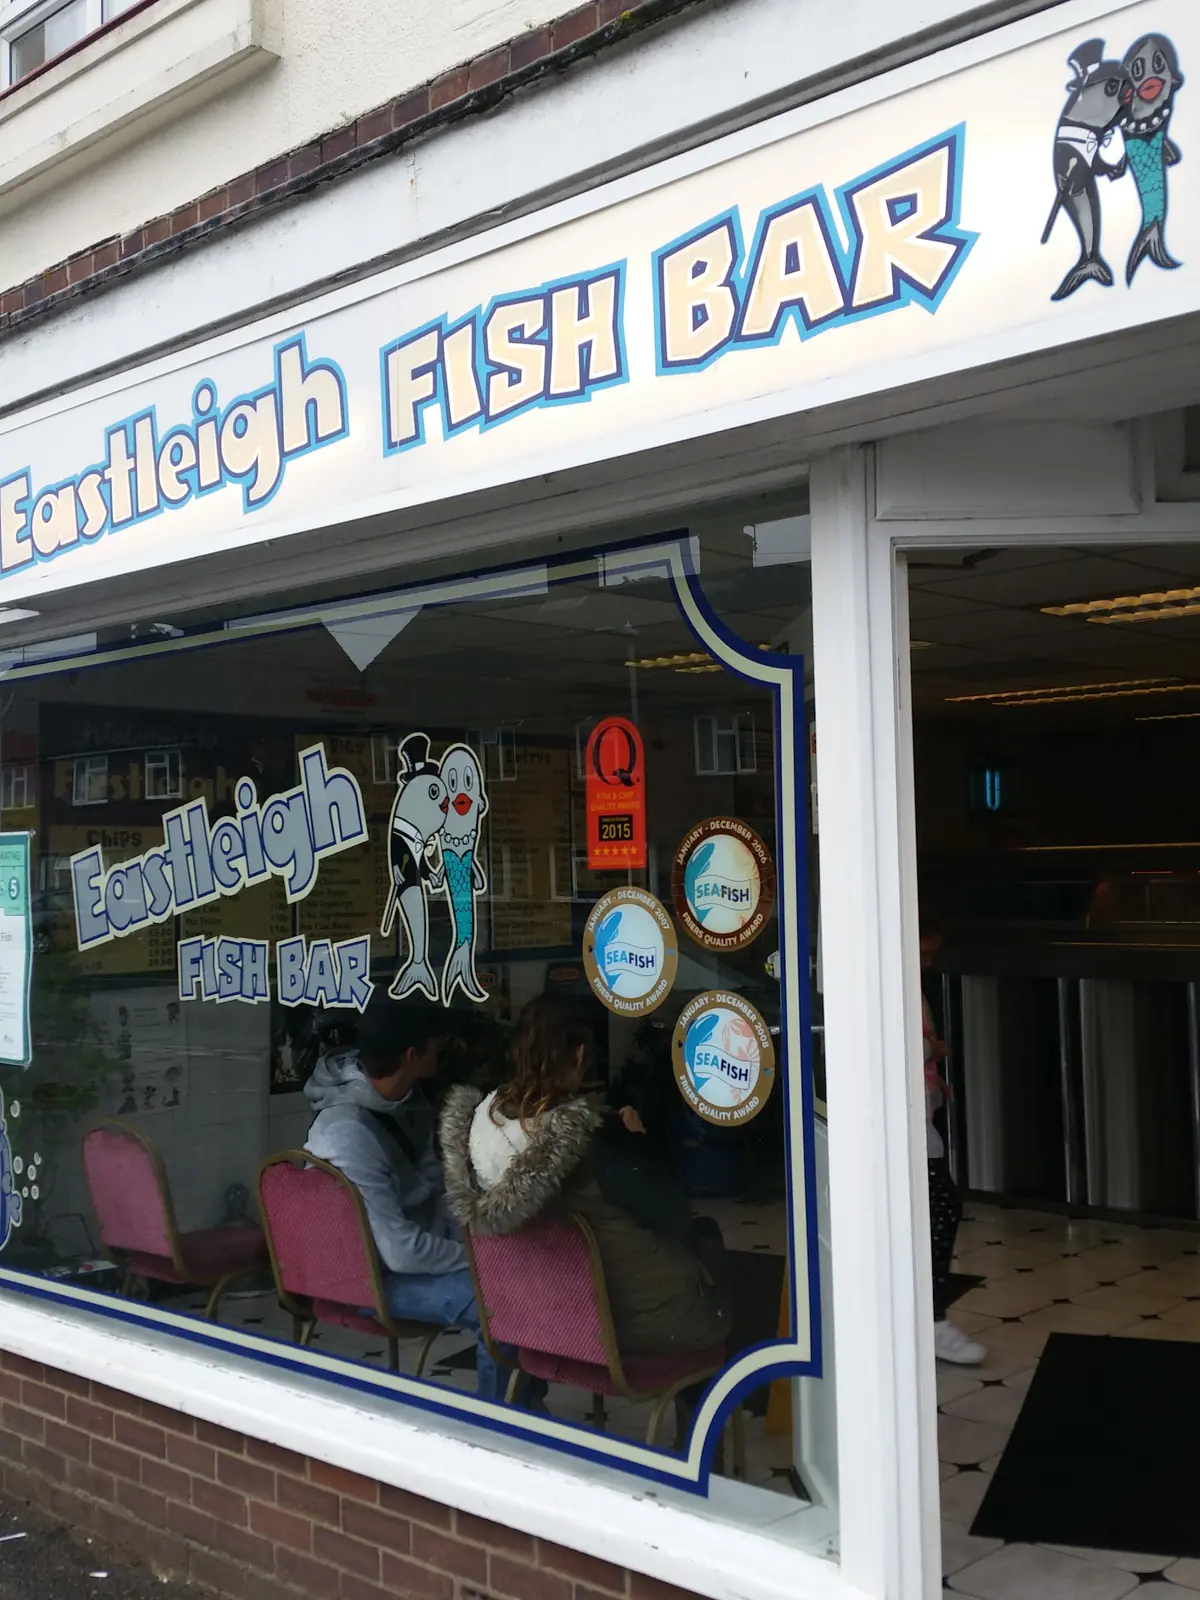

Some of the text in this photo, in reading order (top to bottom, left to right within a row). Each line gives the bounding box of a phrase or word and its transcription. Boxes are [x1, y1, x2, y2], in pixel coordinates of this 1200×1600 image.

[0, 122, 980, 578] Eastleigh FISH BAR
[70, 741, 369, 952] Eastleigh
[602, 823, 631, 839] 2015
[677, 827, 703, 865] JANUARY
[710, 820, 752, 841] DECEMBER
[751, 839, 768, 864] 2006
[10, 879, 19, 898] 5
[696, 883, 749, 903] SEAFISH
[588, 896, 612, 933] JANUARY
[617, 890, 657, 909] DECEMBER
[655, 908, 670, 929] 2007
[681, 911, 764, 947] FRIERS QUALITY AWARD
[177, 934, 376, 1014] FISH BAR
[606, 950, 655, 969] SEAFISH
[594, 977, 668, 1011] FRIERS QUALITY AWARD
[680, 995, 709, 1029] JANUARY
[716, 994, 757, 1023] DECEMBER
[755, 1021, 769, 1049] 2008
[696, 1053, 749, 1082] SEAFISH
[680, 1075, 759, 1120] FRIERS QUALITY AWARD
